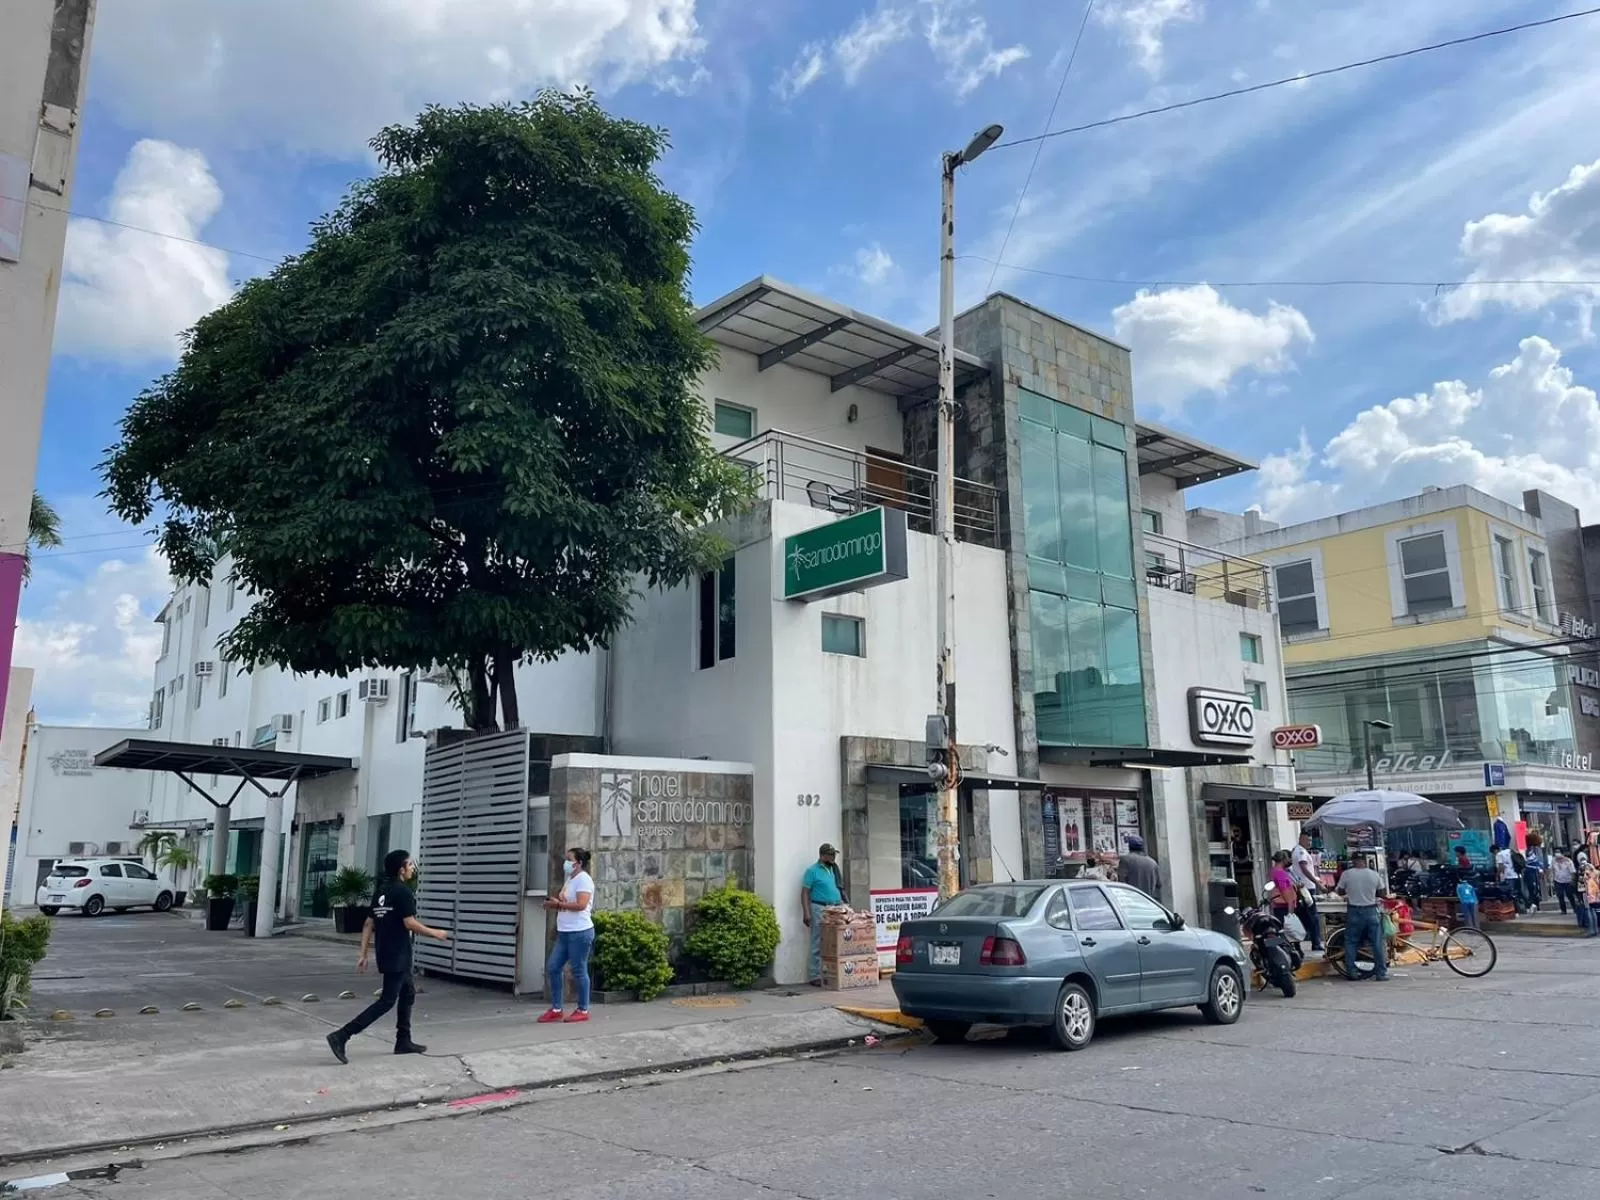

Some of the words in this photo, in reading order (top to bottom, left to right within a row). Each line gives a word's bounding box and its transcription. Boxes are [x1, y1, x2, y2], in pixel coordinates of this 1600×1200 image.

[804, 532, 880, 568] santodomingo
[1572, 615, 1598, 639] telcel
[1203, 700, 1254, 733] OXXO
[1274, 728, 1316, 745] OXXO
[1561, 749, 1592, 770] telcel
[639, 771, 681, 796] hotel
[796, 793, 821, 807] 802
[1289, 806, 1311, 814] OXXO
[638, 797, 752, 828] santodomingo
[876, 914, 885, 923] DE
[887, 913, 901, 922] 6AM
[903, 912, 908, 920] A
[883, 904, 910, 912] CUALQUIER
